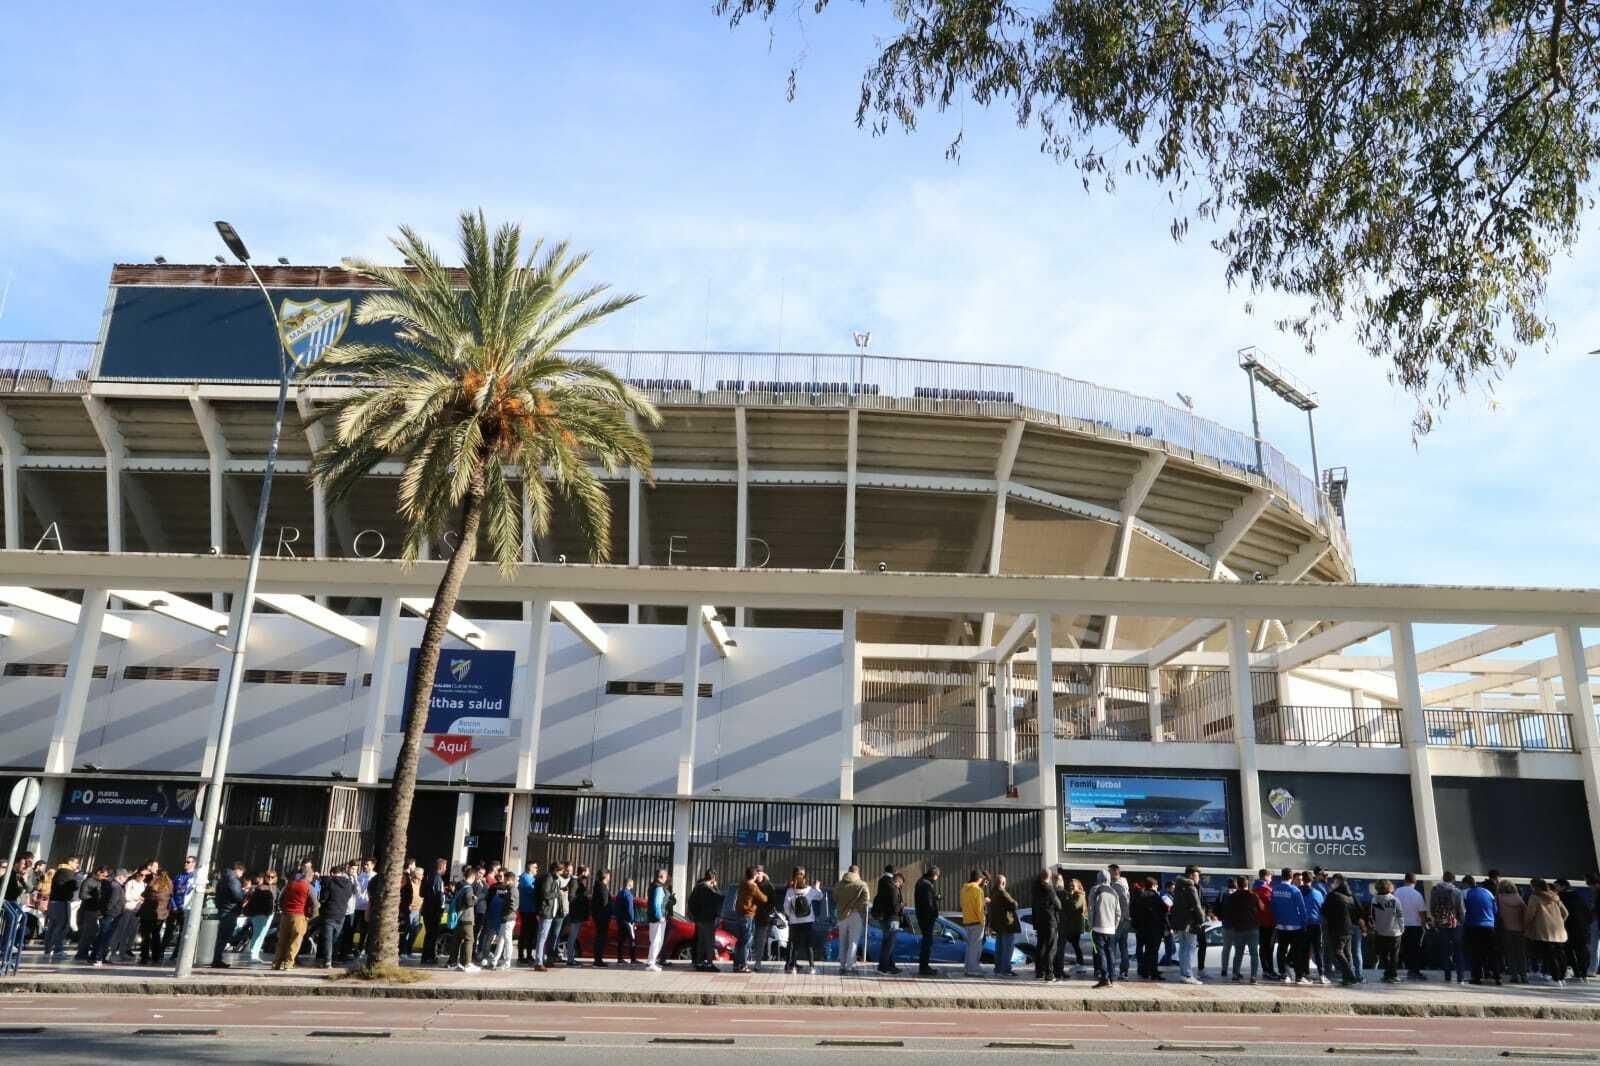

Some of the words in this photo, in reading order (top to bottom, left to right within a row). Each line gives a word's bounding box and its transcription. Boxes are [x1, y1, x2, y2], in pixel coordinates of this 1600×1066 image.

[468, 697, 503, 710] salud
[437, 741, 468, 754] Aquí
[1267, 823, 1365, 841] TAQUILLAS
[1270, 841, 1311, 854] TICKET
[1314, 842, 1367, 856] OFFICES
